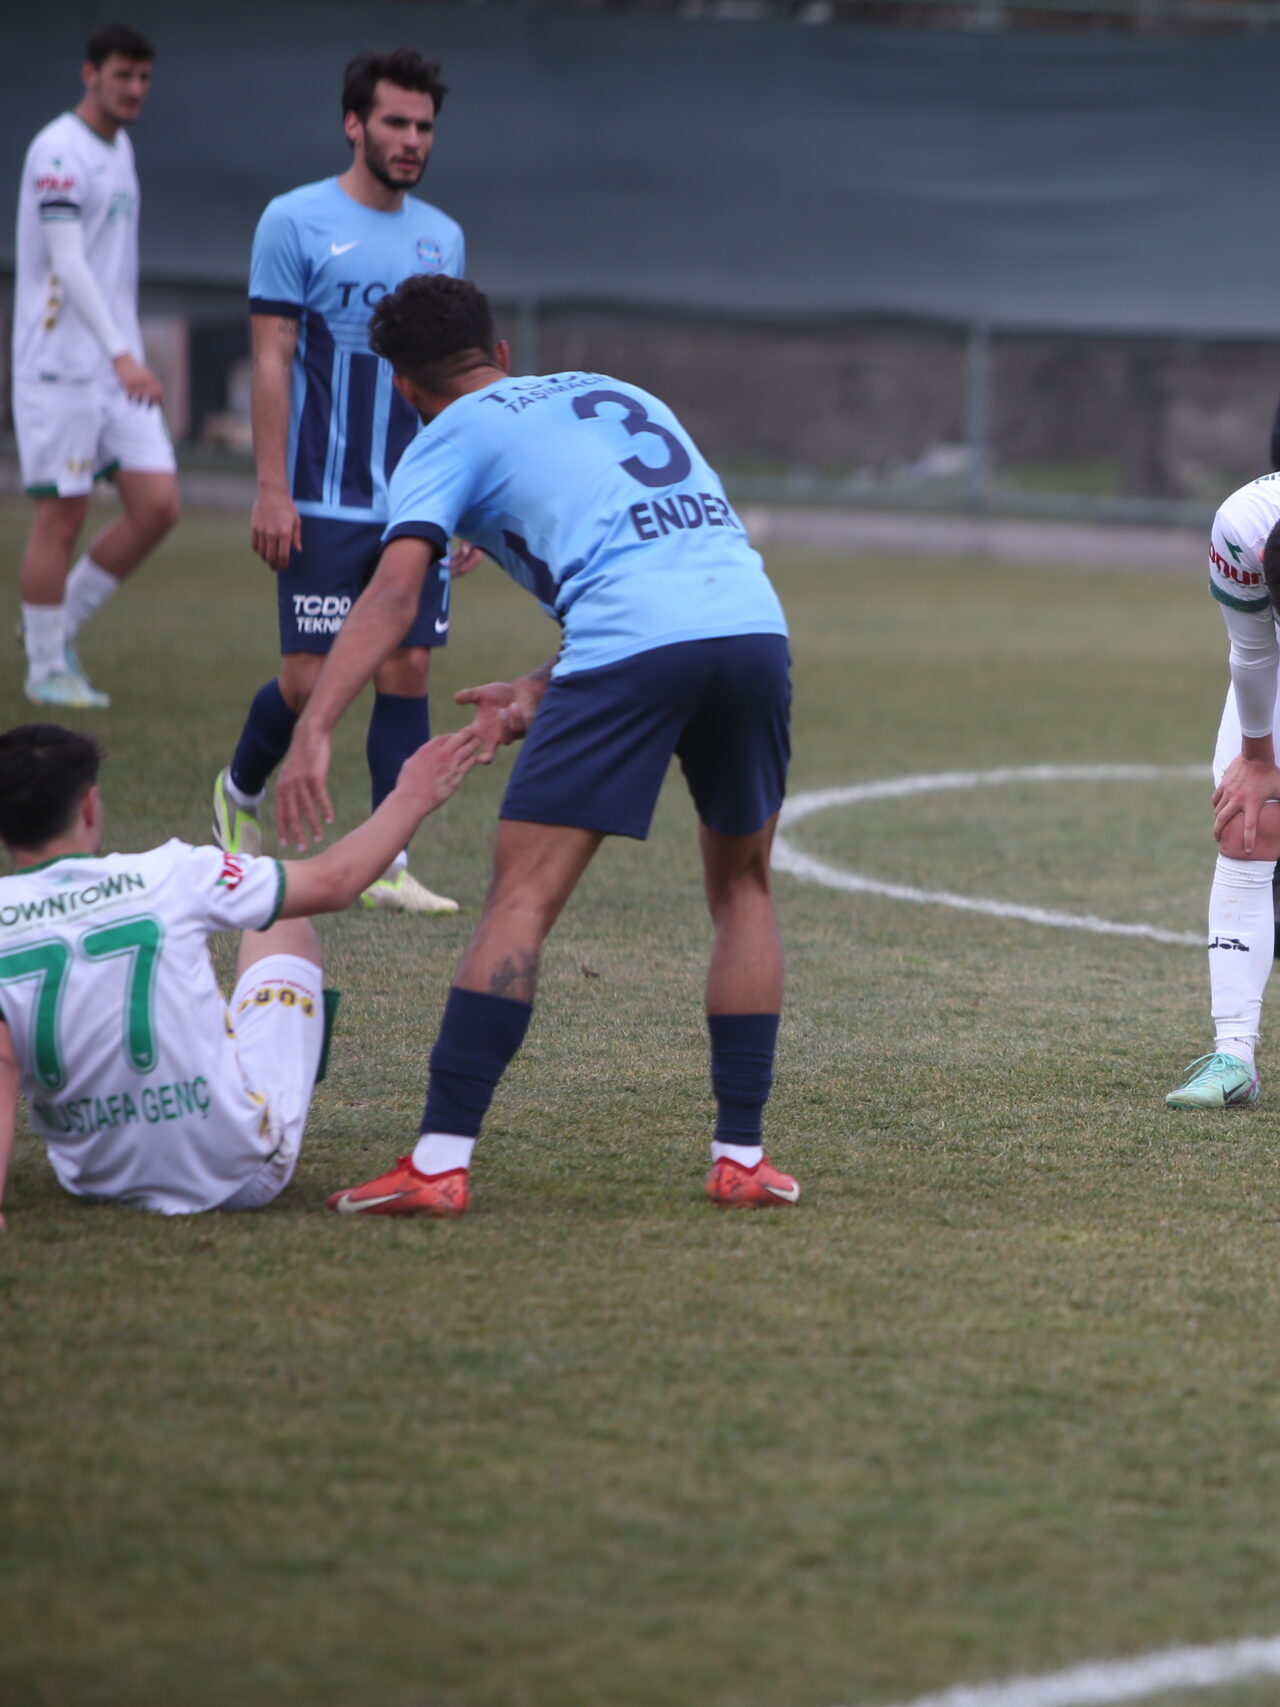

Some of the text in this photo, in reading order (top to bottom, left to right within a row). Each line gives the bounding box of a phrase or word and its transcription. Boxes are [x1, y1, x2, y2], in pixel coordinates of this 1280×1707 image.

[336, 281, 401, 309] TC
[571, 390, 692, 488] 3
[630, 492, 740, 541] ENDER
[293, 594, 351, 616] TCDD
[0, 913, 164, 1091] 77
[141, 1076, 210, 1123] GENÇ
